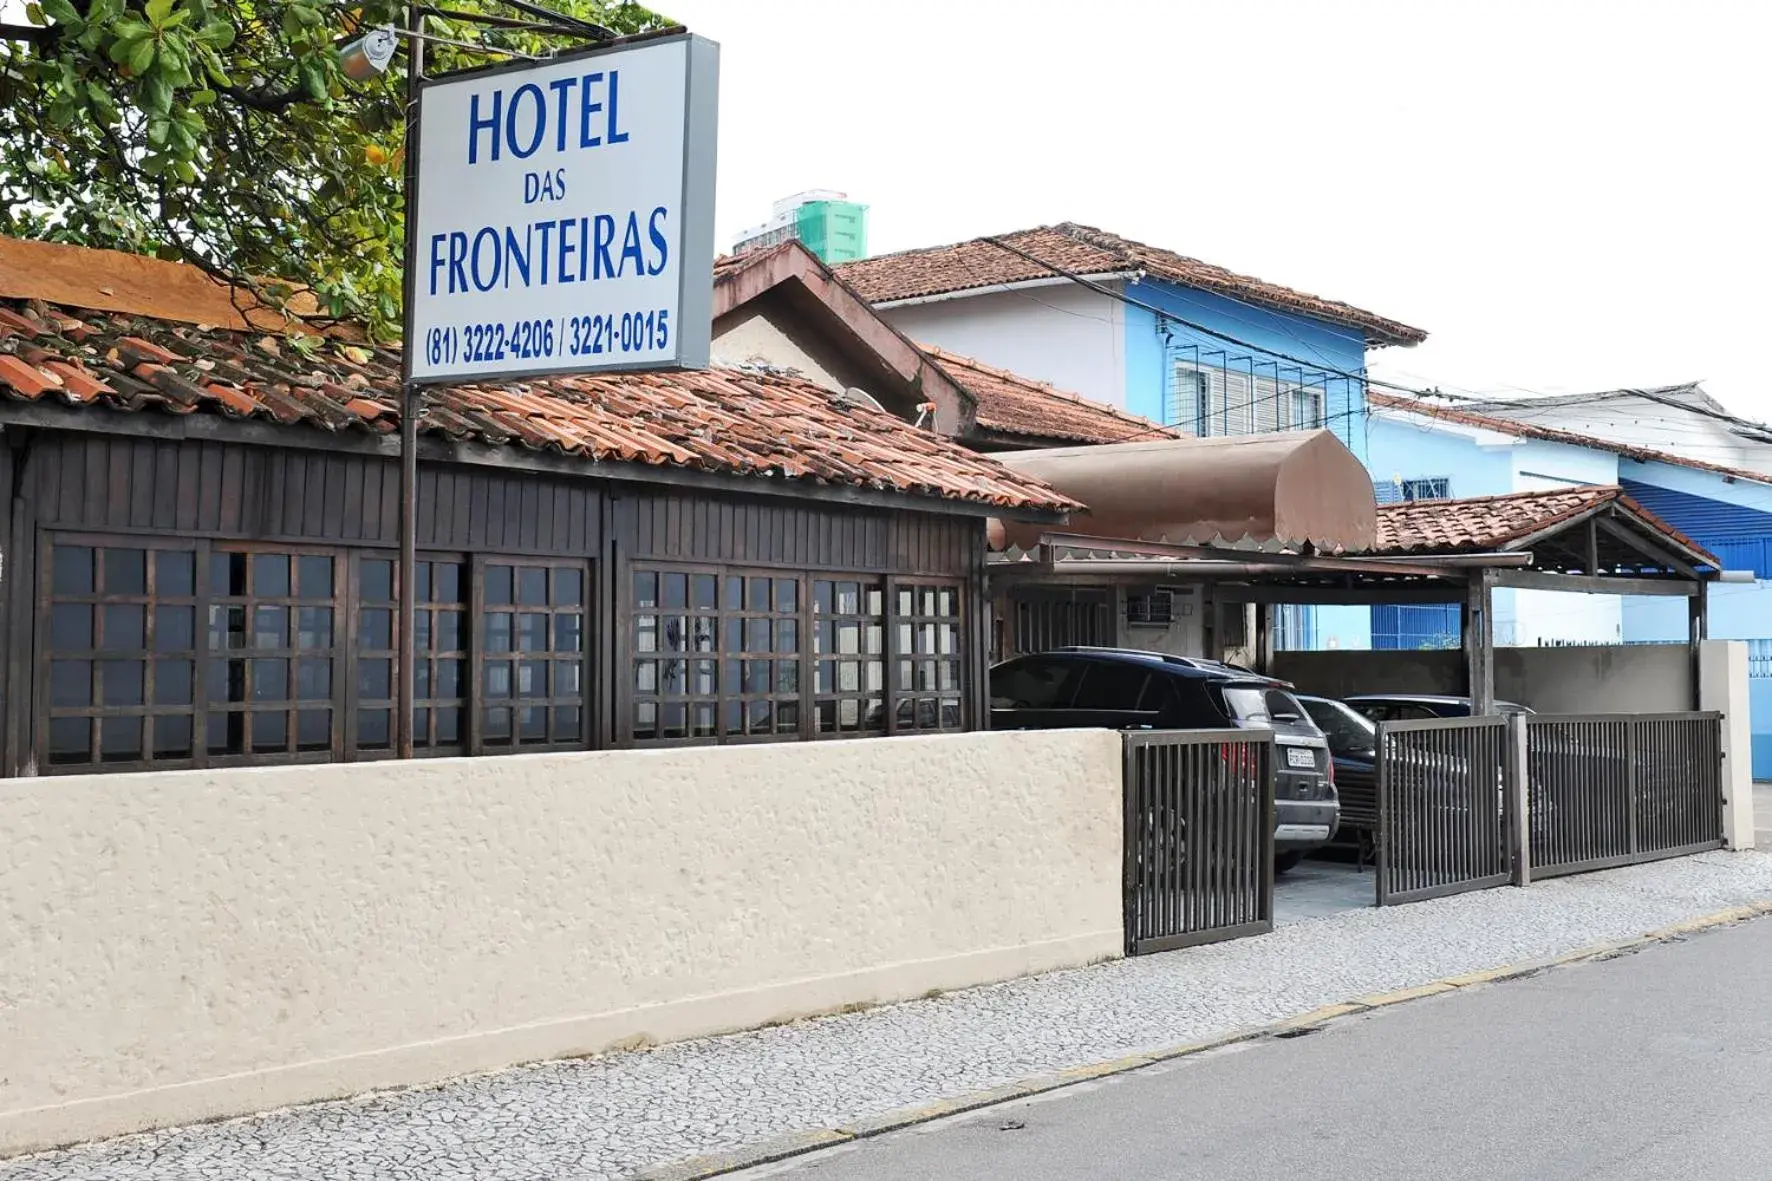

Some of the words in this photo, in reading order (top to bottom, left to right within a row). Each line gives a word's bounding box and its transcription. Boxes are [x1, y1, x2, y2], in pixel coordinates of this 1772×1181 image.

[468, 70, 629, 164] HOTEL
[524, 168, 566, 204] DAS
[430, 206, 668, 295] FRONTEIRAS
[426, 326, 457, 366] (81)
[558, 318, 565, 356] /
